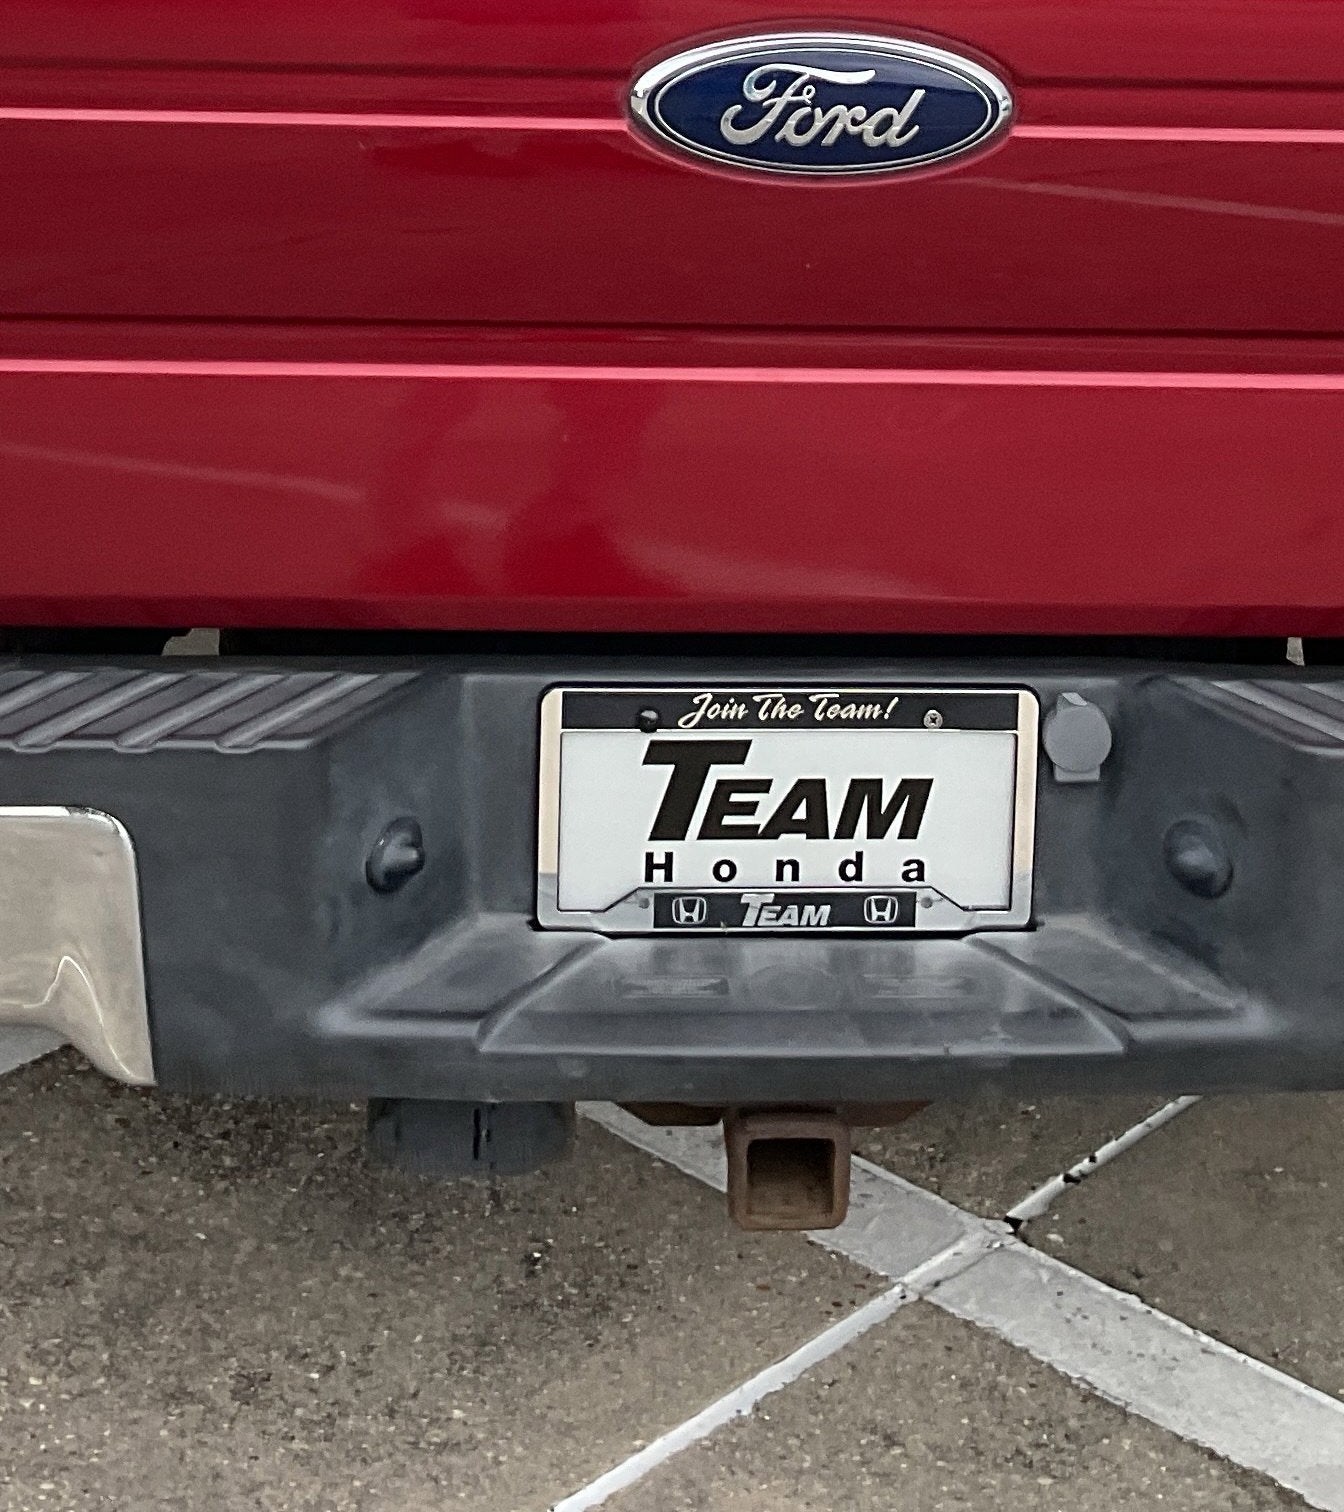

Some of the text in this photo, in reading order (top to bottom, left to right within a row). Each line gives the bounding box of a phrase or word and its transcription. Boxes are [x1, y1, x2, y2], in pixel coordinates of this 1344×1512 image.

[719, 62, 926, 148] Ford
[677, 692, 899, 728] Join The Team!
[642, 739, 934, 841] TEAM
[644, 850, 926, 883] Honda
[740, 892, 831, 927] TEAM
